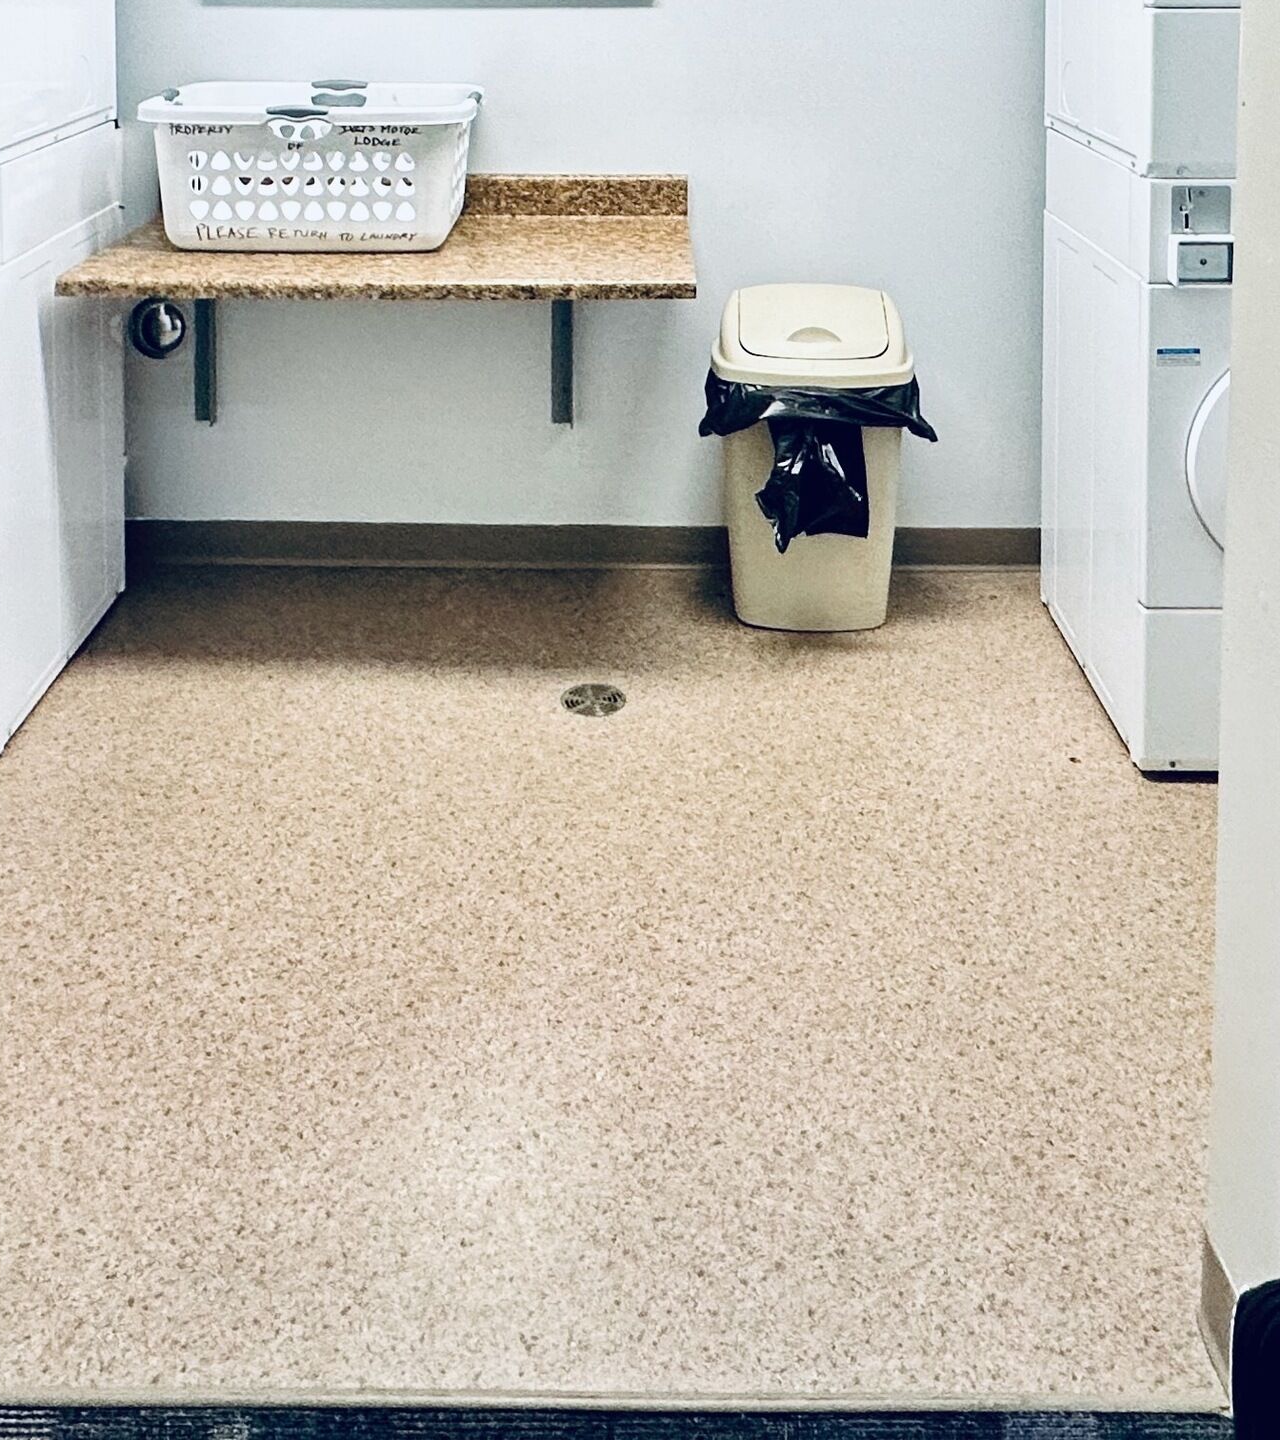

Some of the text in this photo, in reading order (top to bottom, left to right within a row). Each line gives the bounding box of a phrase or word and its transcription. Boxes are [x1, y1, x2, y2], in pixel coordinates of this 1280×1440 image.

[169, 123, 234, 136] PROPERTY
[380, 124, 423, 136] MOTOR
[354, 136, 402, 147] LODGE
[195, 223, 259, 241] PLEASE
[338, 232, 354, 241] TO
[360, 232, 418, 242] LAUNDRY
